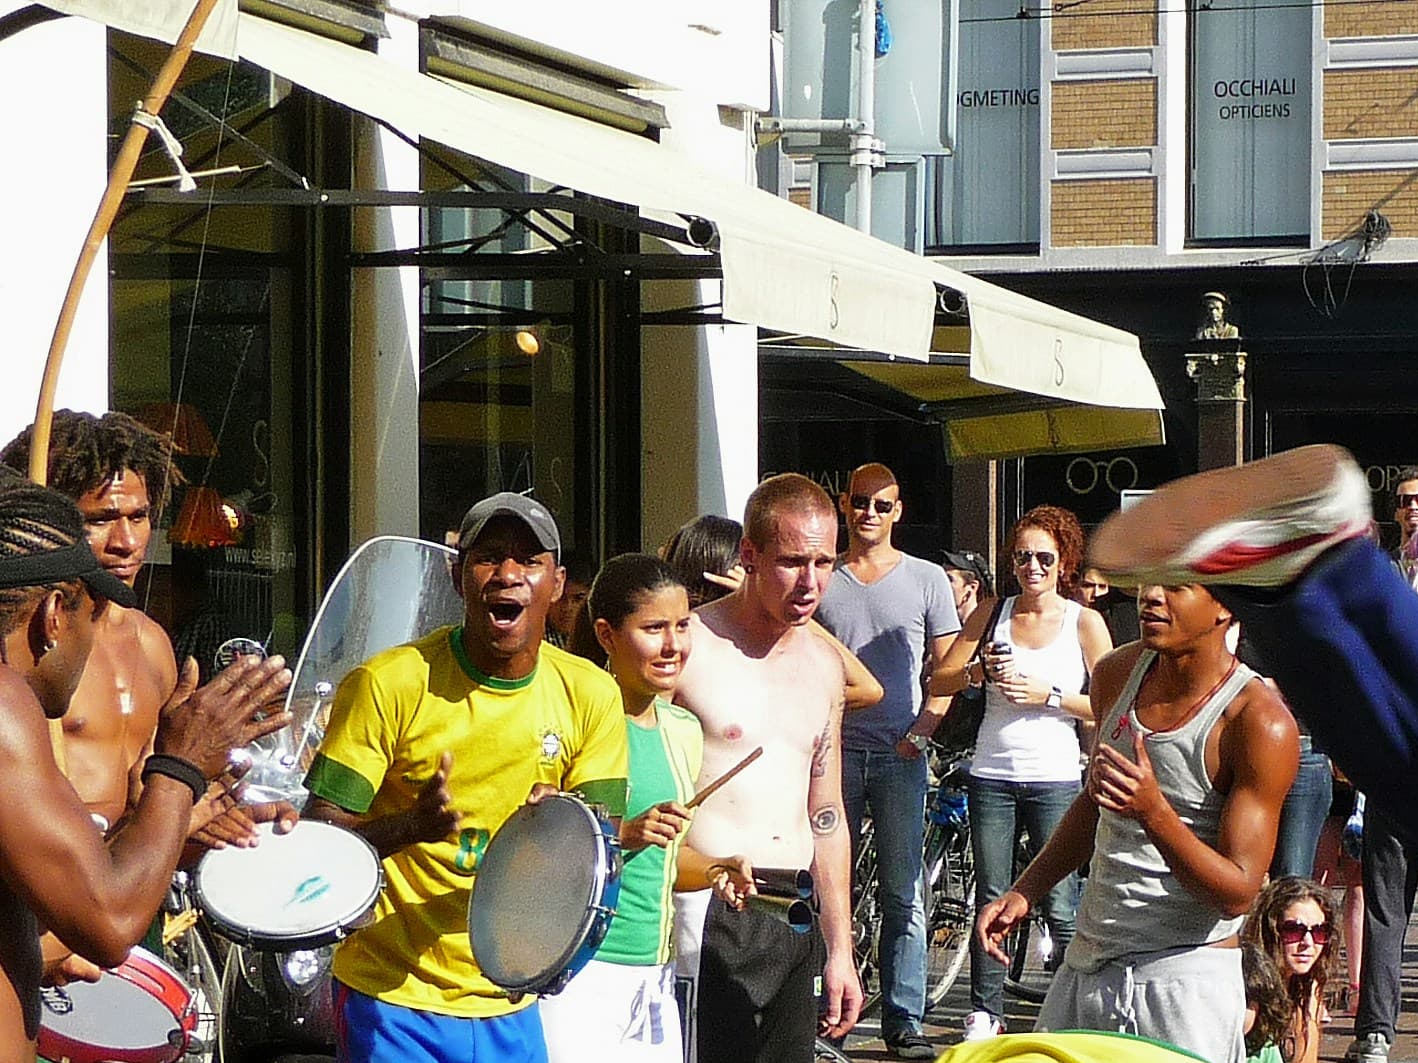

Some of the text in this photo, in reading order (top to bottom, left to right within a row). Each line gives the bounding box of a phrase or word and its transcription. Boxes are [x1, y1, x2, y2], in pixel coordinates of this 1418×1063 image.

[956, 88, 1039, 107] GMETING
[1214, 78, 1296, 98] OCCHIALI
[1219, 103, 1290, 120] OPTICIENS
[455, 827, 491, 873] 8
